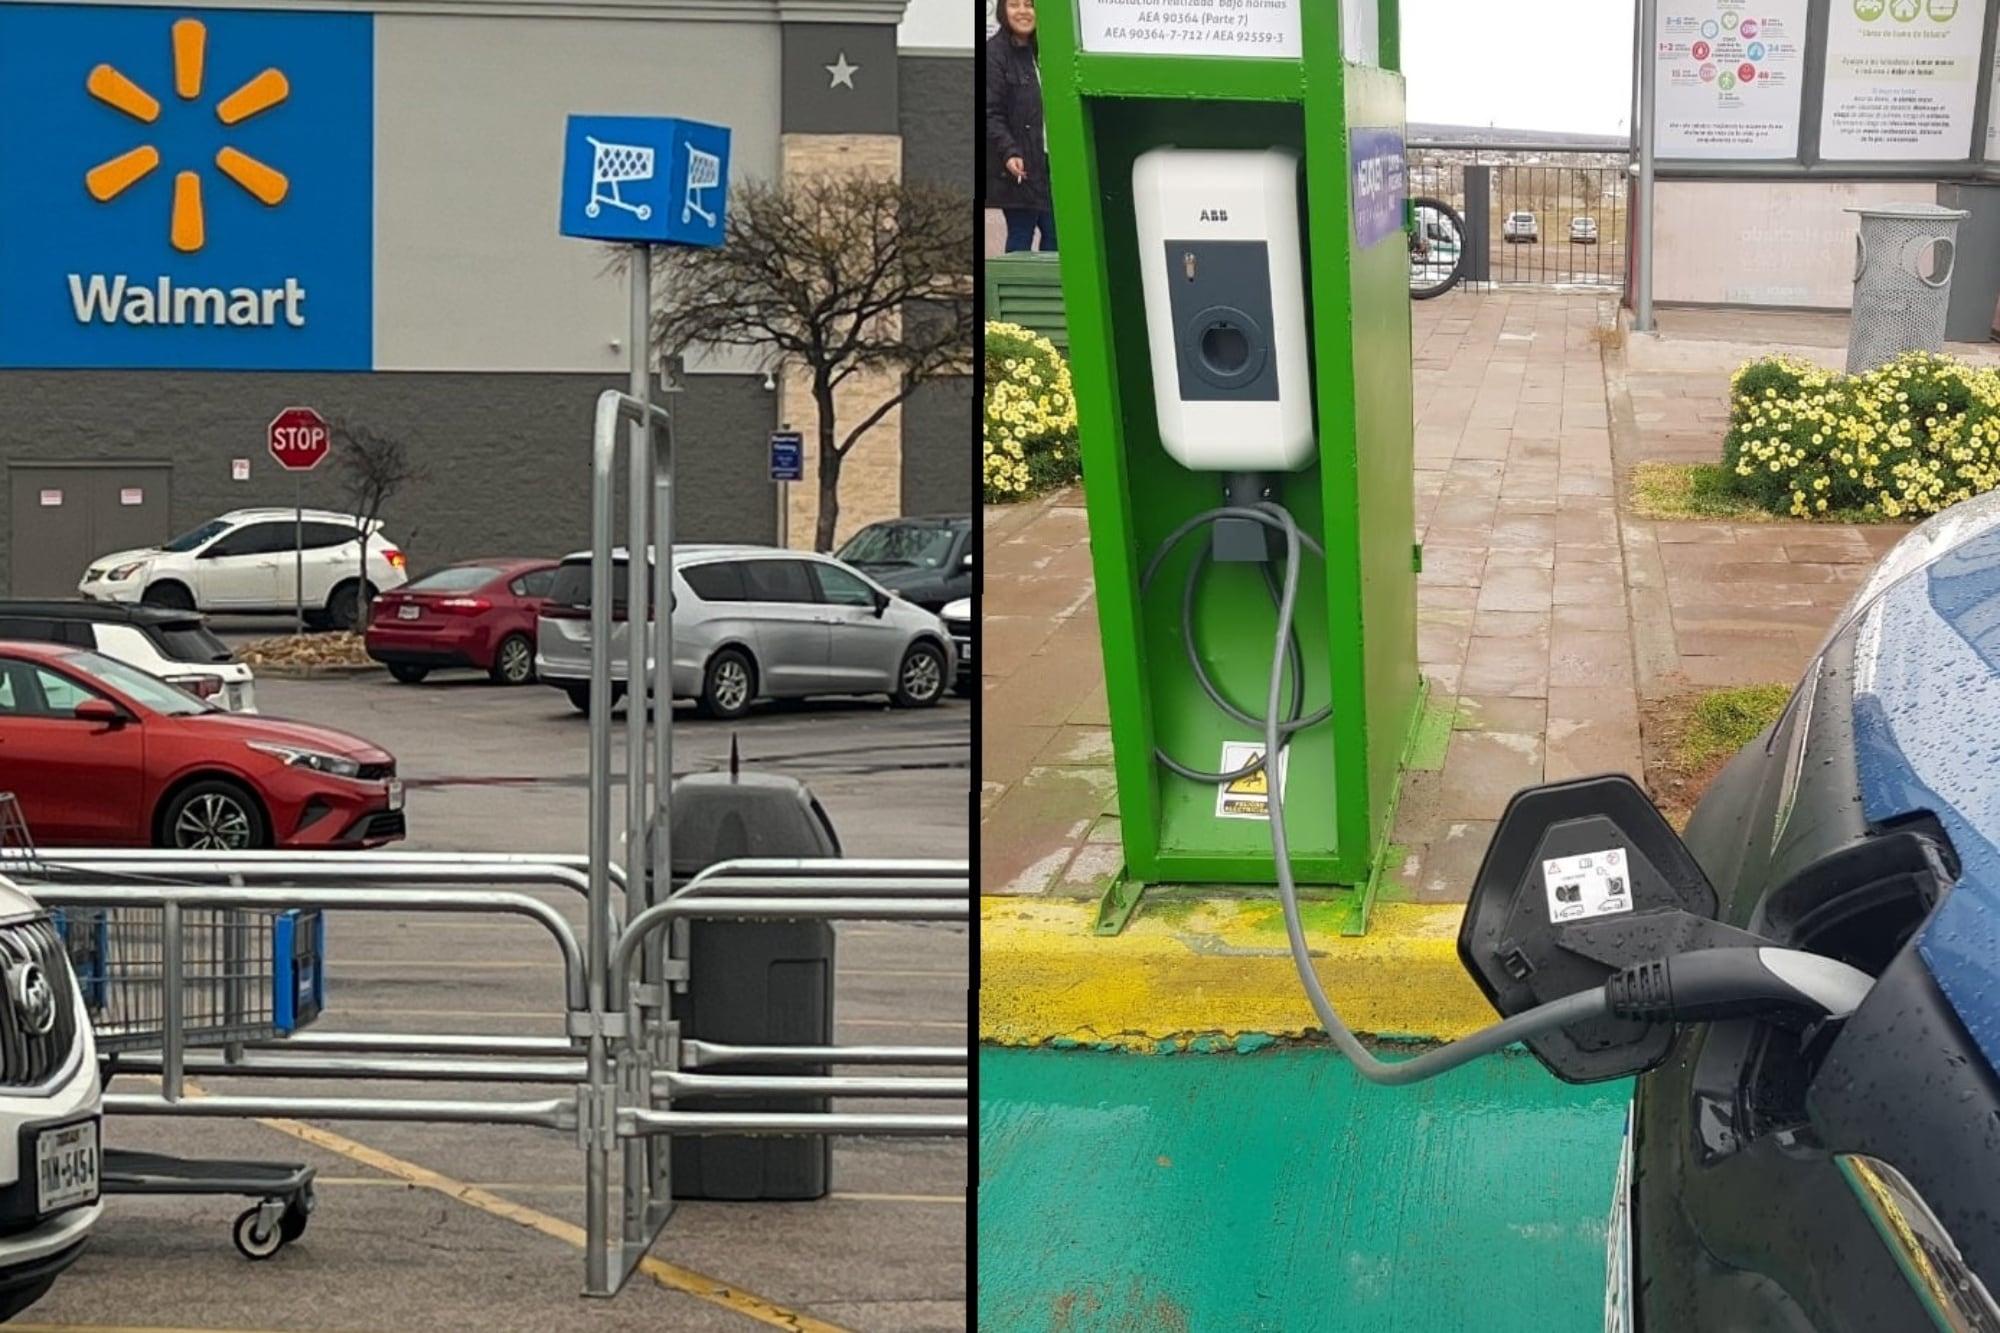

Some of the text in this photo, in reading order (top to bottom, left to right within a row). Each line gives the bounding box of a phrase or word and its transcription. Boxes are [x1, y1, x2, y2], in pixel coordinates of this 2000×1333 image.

[1245, 1, 1287, 9] normas
[1138, 11, 1160, 23] AEA
[1163, 12, 1198, 24] 90364
[1202, 12, 1235, 25] (Parte
[1104, 27, 1127, 38] AEA
[1212, 30, 1234, 41] AEA
[1200, 209, 1229, 221] ABB
[68, 274, 305, 326] Walmart
[274, 427, 324, 450] STOP
